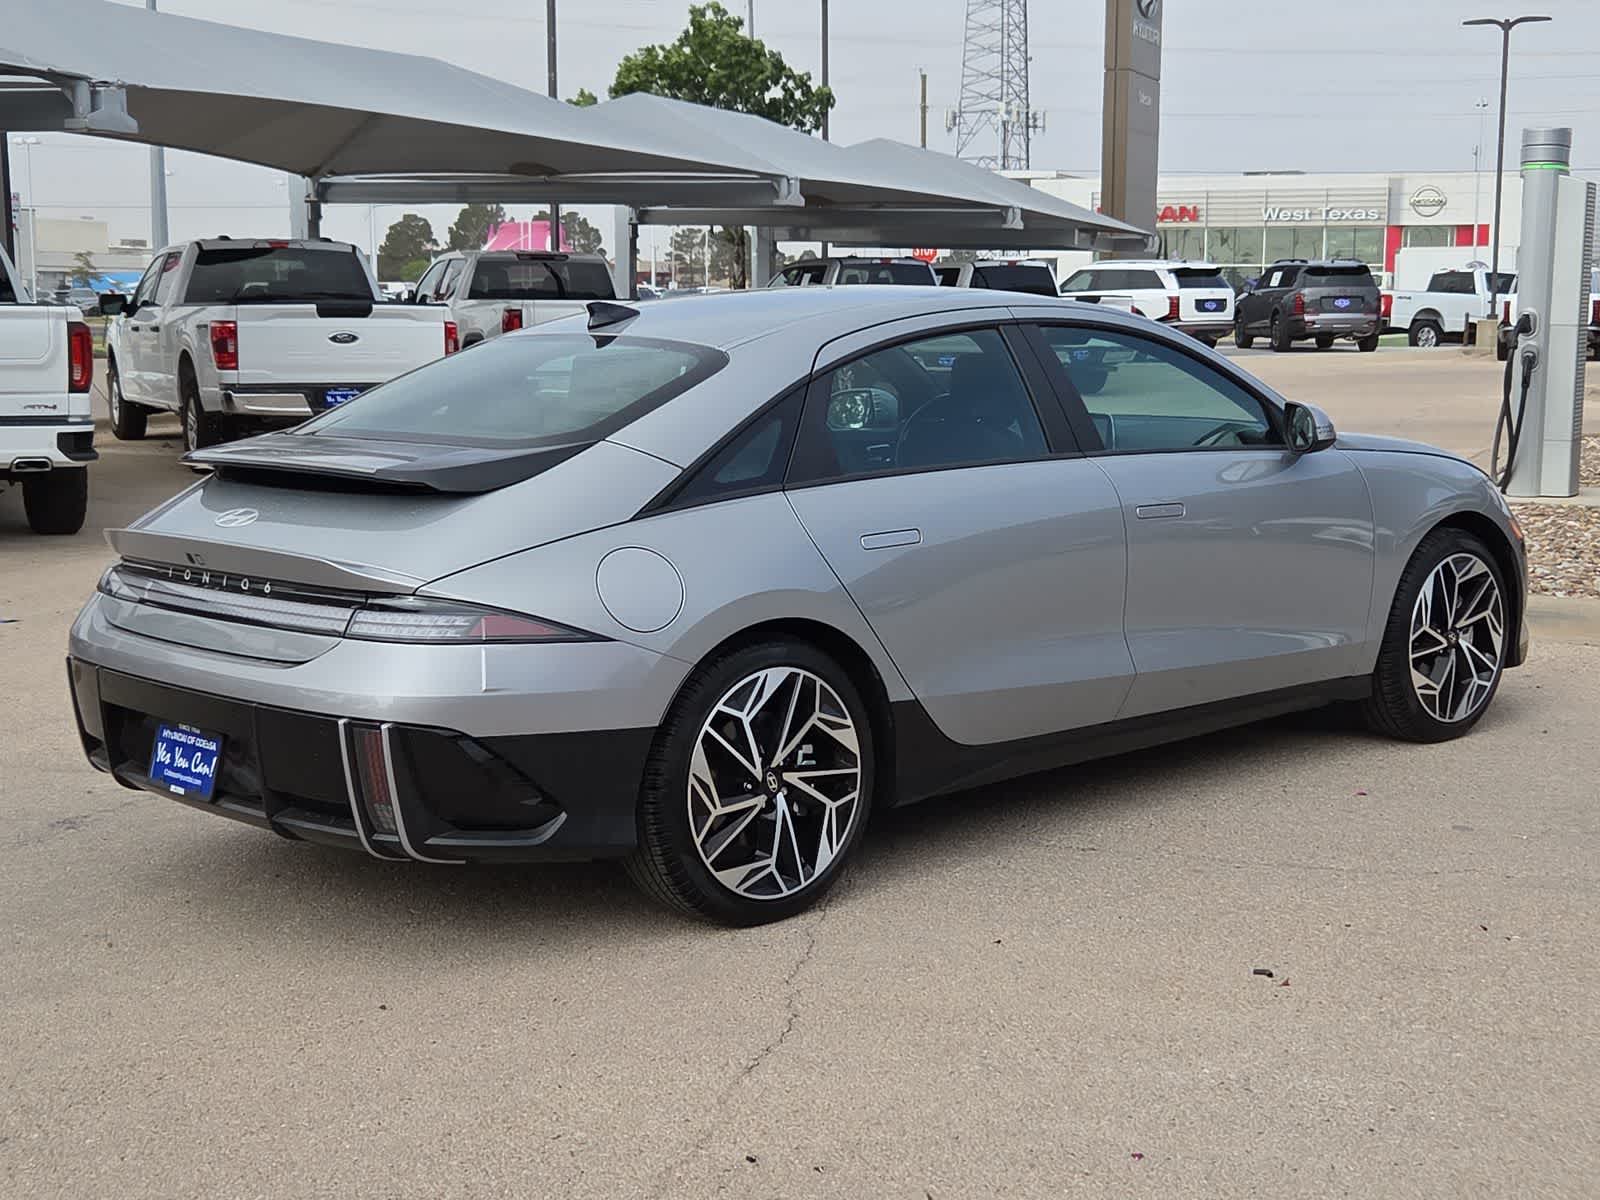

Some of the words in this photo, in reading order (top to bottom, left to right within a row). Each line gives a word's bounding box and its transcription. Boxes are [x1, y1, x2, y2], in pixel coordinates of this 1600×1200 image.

[1262, 208, 1312, 221] West
[1319, 207, 1380, 221] Texas
[168, 567, 250, 590] IONIQ
[156, 742, 171, 765] Yes
[173, 746, 189, 768] You
[191, 752, 218, 778] Can!
